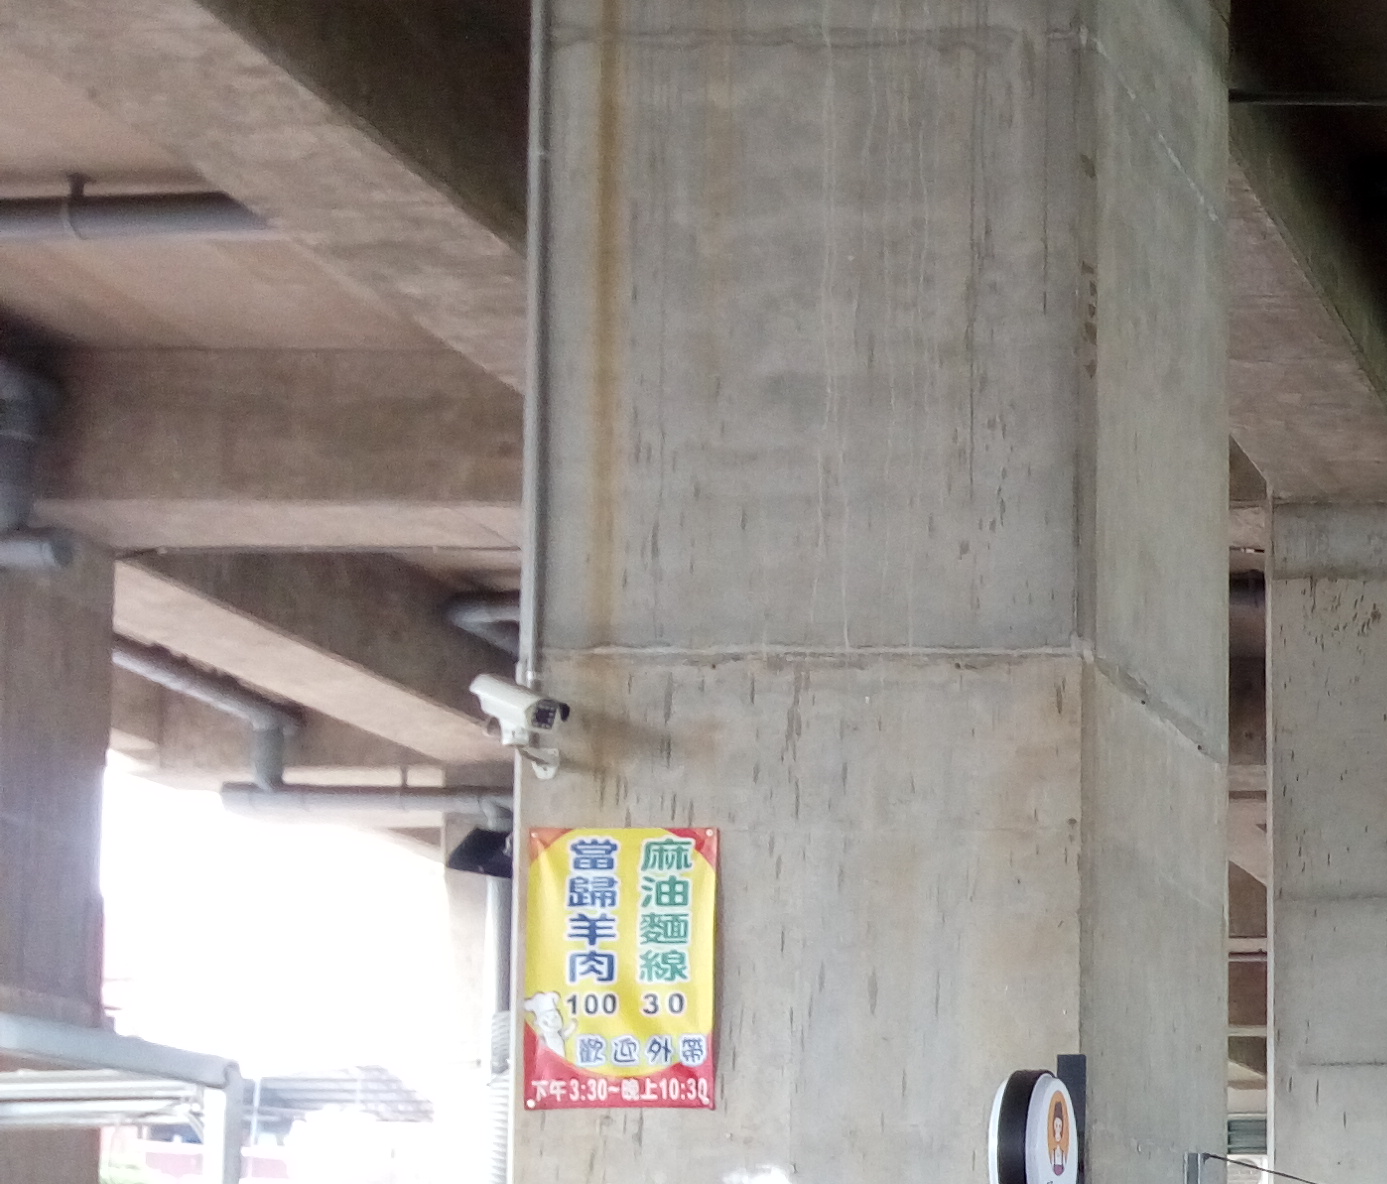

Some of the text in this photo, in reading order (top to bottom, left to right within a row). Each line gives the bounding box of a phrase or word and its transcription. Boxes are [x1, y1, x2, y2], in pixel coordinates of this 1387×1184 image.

[567, 839, 618, 982] 當歸羊肉
[641, 838, 693, 982] 麻油麵線
[568, 994, 617, 1015] 100
[642, 994, 685, 1015] 30
[579, 1037, 704, 1064] 歡迎外帶
